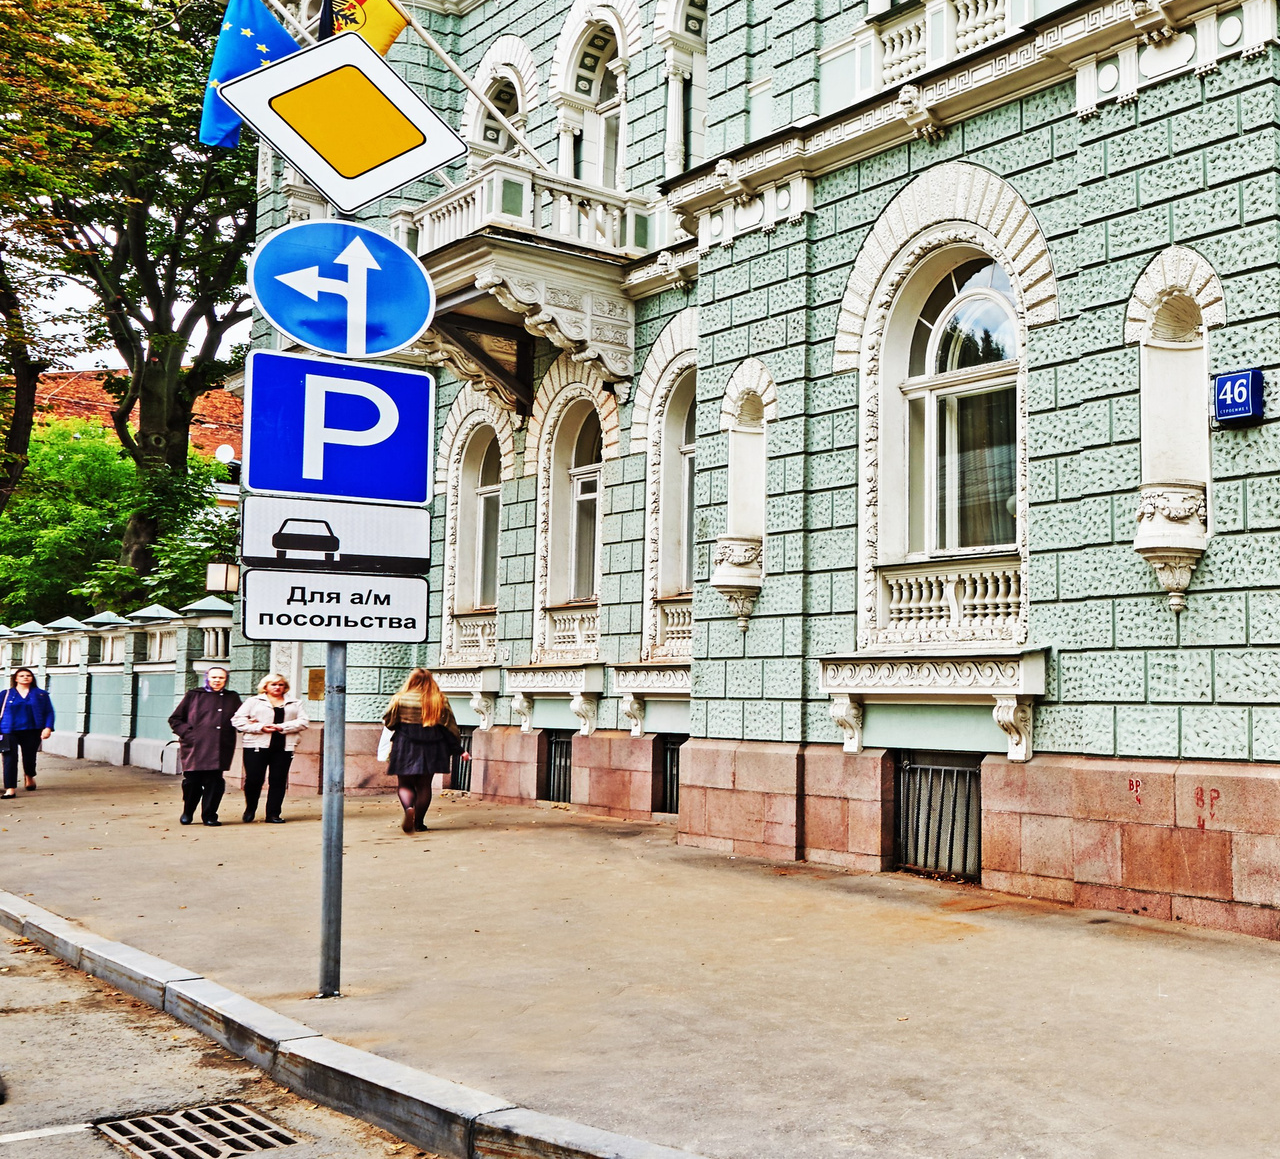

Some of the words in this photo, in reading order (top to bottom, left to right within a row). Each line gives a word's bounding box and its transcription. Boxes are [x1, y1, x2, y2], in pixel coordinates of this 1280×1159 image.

[1218, 378, 1248, 405] 46
[301, 373, 400, 481] P
[286, 585, 341, 606] Для
[349, 589, 392, 607] а/м
[258, 611, 417, 630] посольства
